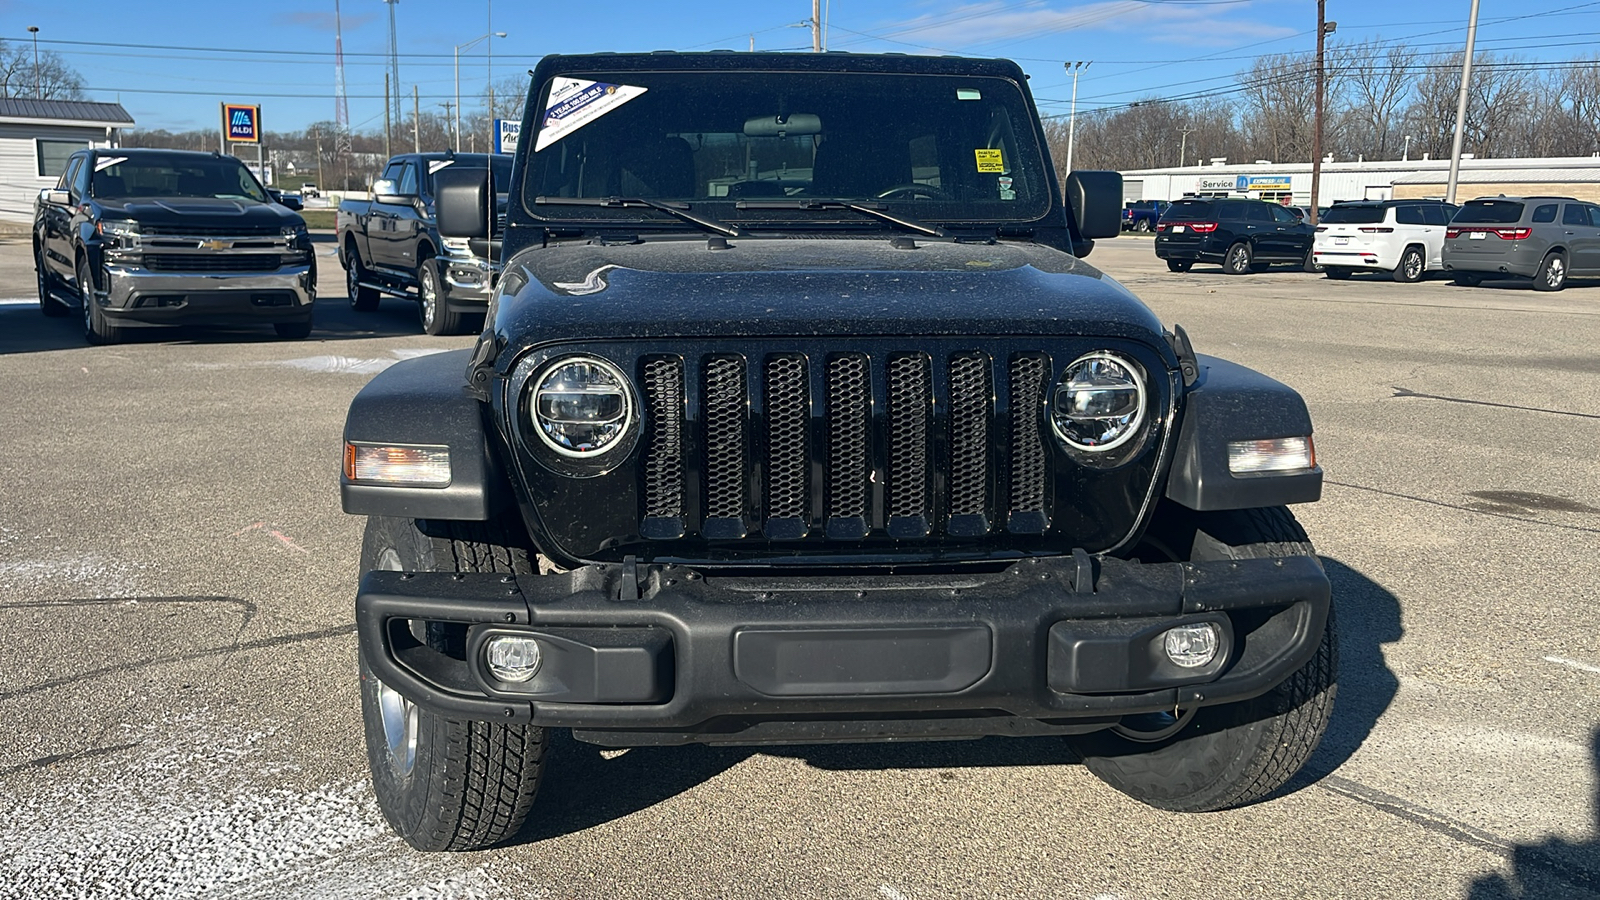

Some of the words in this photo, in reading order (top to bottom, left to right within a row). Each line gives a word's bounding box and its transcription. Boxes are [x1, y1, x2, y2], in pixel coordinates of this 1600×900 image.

[554, 104, 572, 115] YEAR
[587, 86, 603, 98] MILE
[232, 126, 252, 134] ALDI
[503, 122, 520, 133] Rus
[503, 133, 518, 143] Au
[1202, 180, 1233, 188] Service
